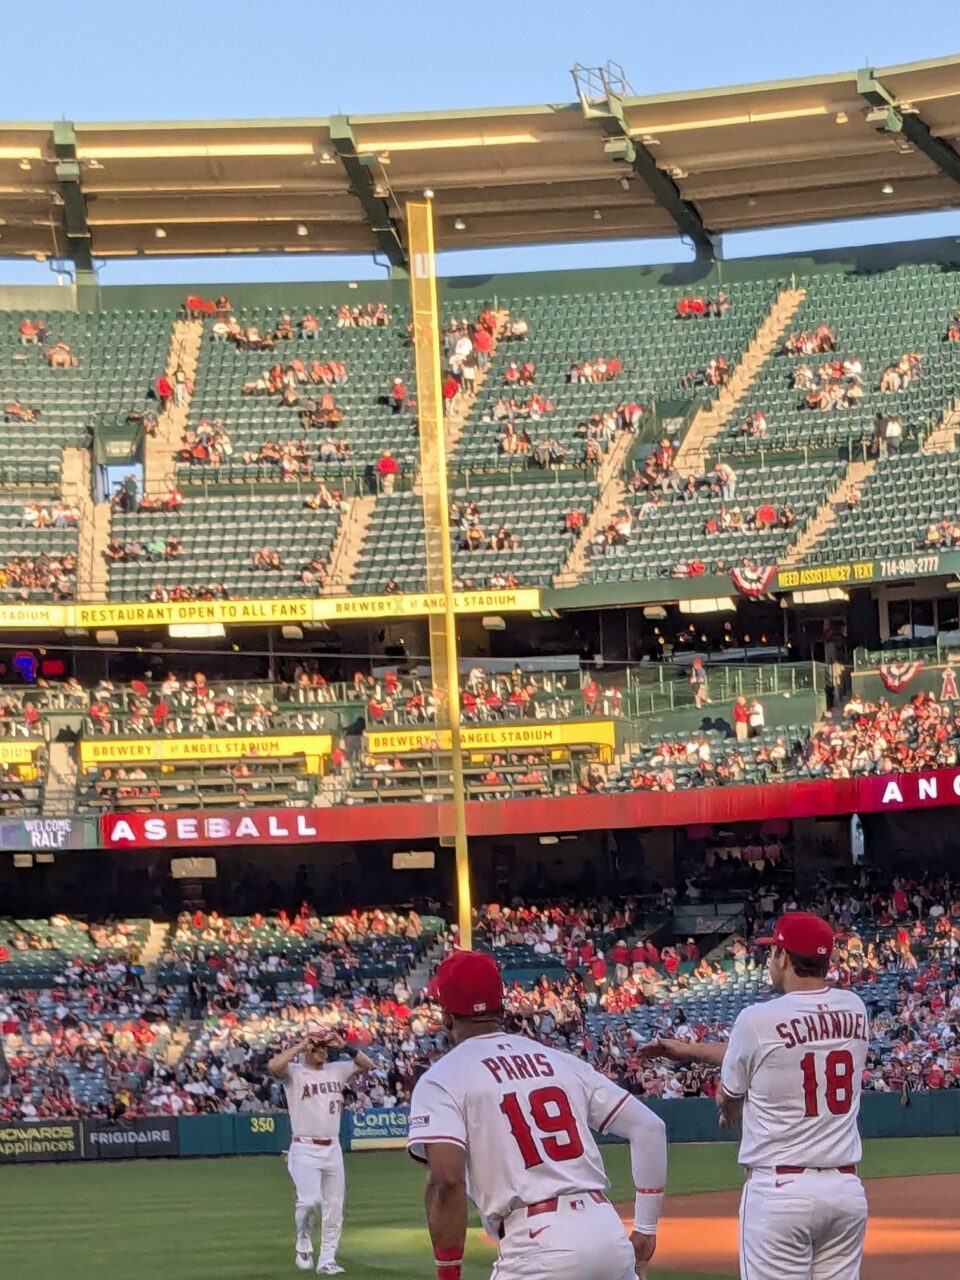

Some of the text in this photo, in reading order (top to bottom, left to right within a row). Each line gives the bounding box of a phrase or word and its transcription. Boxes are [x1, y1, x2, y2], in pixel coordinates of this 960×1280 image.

[778, 556, 939, 587] NEED ASSISTANCE? TEXT 714-940-2777
[81, 603, 307, 623] RESTAURANT OPEN TO ALL FANS
[335, 601, 392, 613] BREWERY
[422, 597, 459, 608] ANGL
[463, 595, 517, 606] STADIUM
[373, 734, 431, 748] BREWERY
[501, 730, 553, 742] STADIUM
[93, 745, 151, 757] BREWERY
[183, 742, 220, 754] ANGEL
[24, 819, 72, 832] WELCOME
[775, 1011, 867, 1049] SCHANUEL
[481, 1053, 555, 1083] PARIS
[800, 1049, 855, 1118] 18
[250, 1117, 274, 1133] 350
[353, 1110, 412, 1127] Conta
[499, 1085, 585, 1169] 19
[90, 1130, 170, 1144] FRIGIDAIRE
